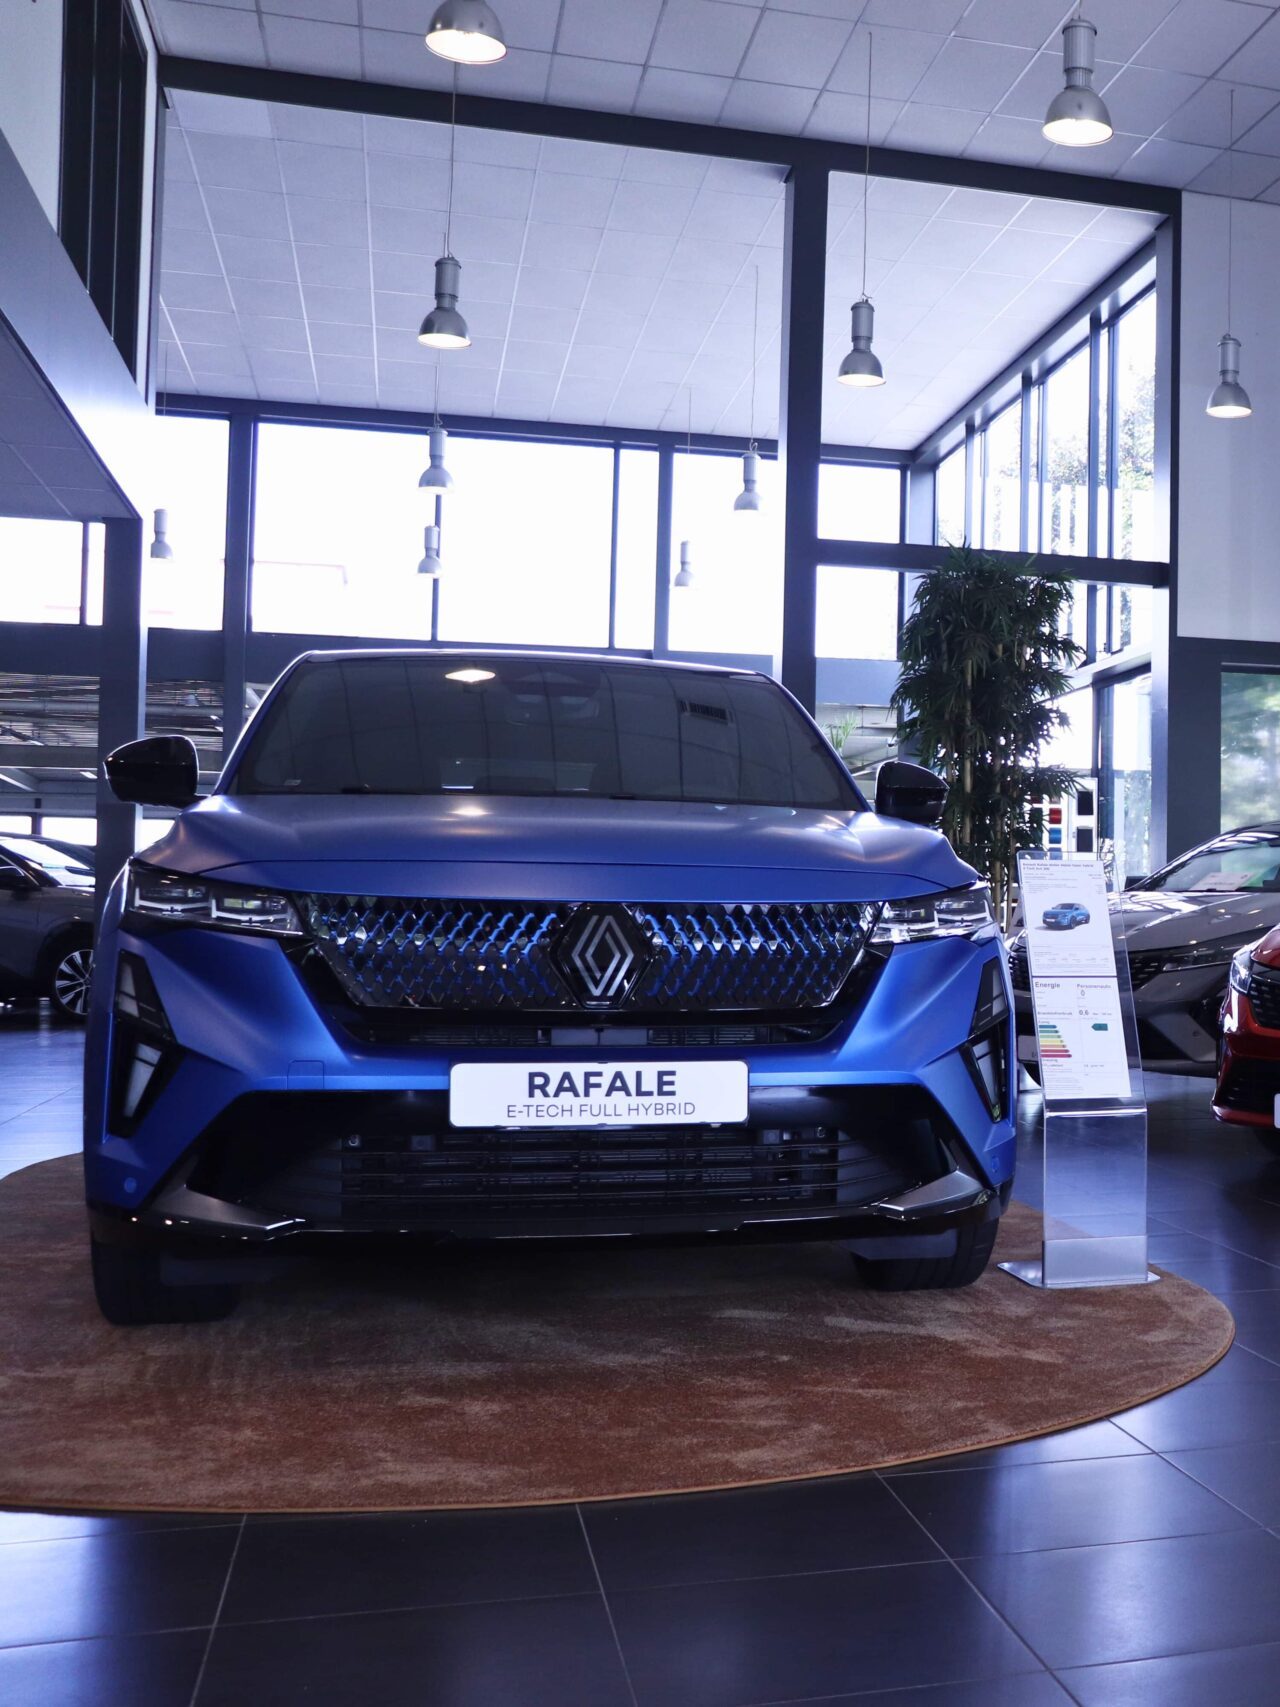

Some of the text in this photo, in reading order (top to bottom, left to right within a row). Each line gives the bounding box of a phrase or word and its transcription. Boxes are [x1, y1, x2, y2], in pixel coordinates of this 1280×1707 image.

[1034, 981, 1061, 990] Energie
[528, 1070, 677, 1098] RAFALE
[507, 1102, 696, 1118] E-TECH FULL HYBRID
